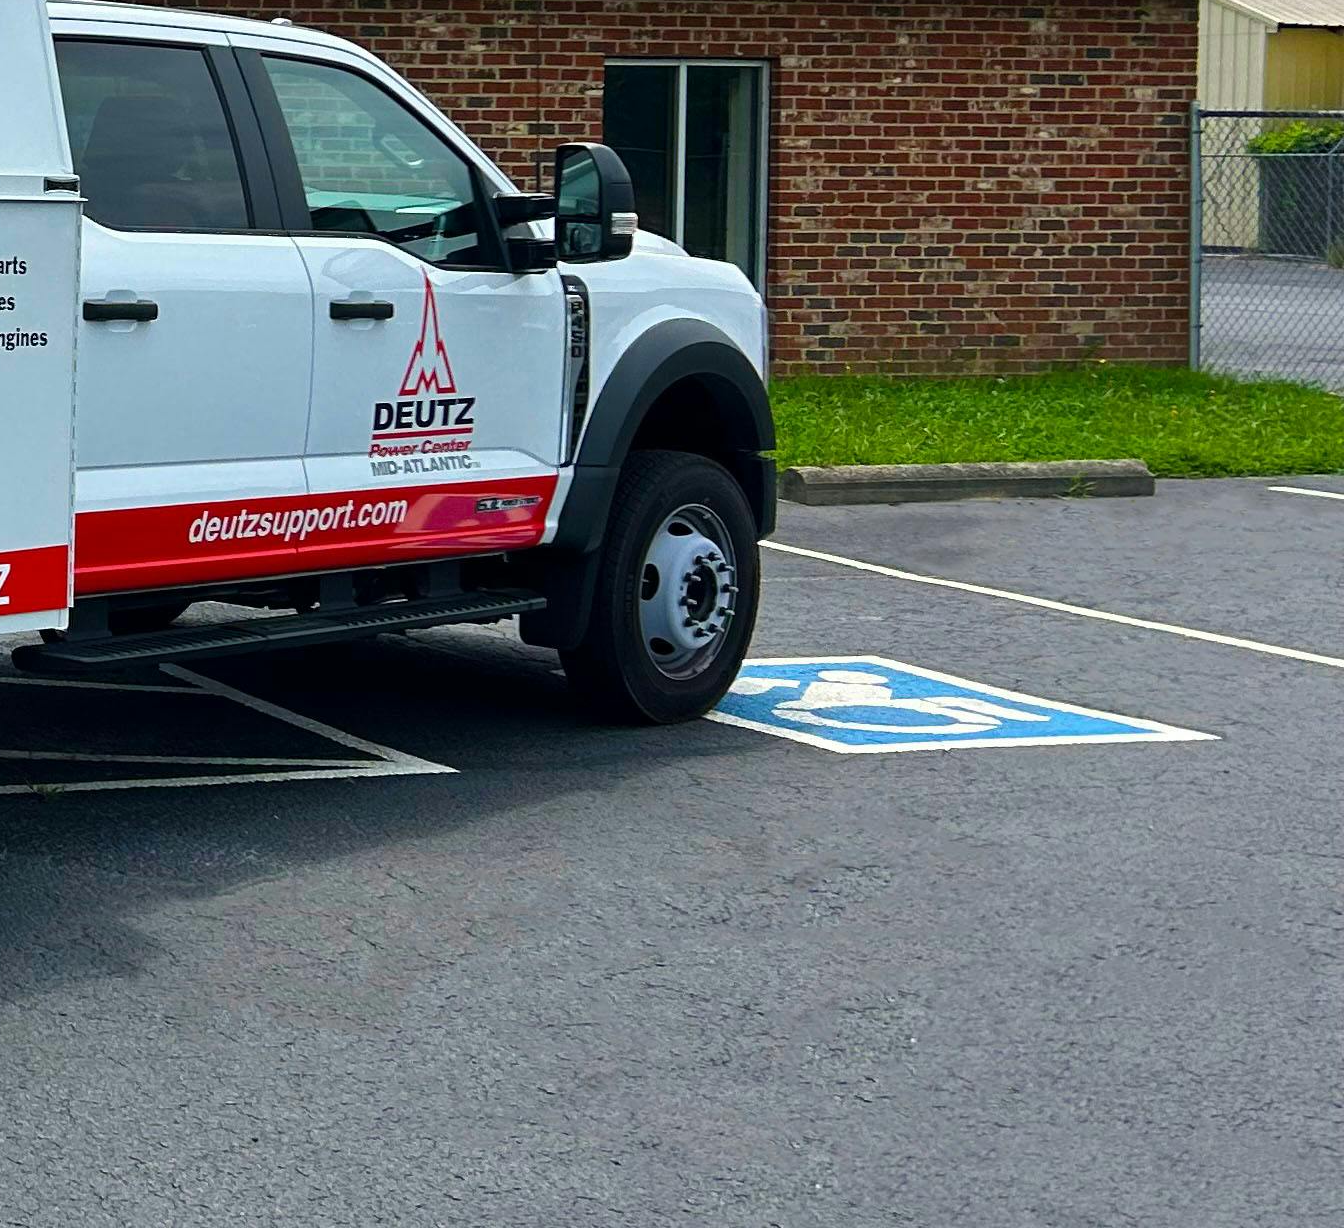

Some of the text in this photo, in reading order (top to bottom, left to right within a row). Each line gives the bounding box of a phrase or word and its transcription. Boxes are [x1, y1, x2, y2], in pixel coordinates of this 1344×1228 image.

[372, 397, 476, 431] DEUTZ
[368, 438, 473, 459] Power Center
[370, 454, 474, 477] MID-ATLANTIC
[188, 499, 409, 543] deutzsupport.com
